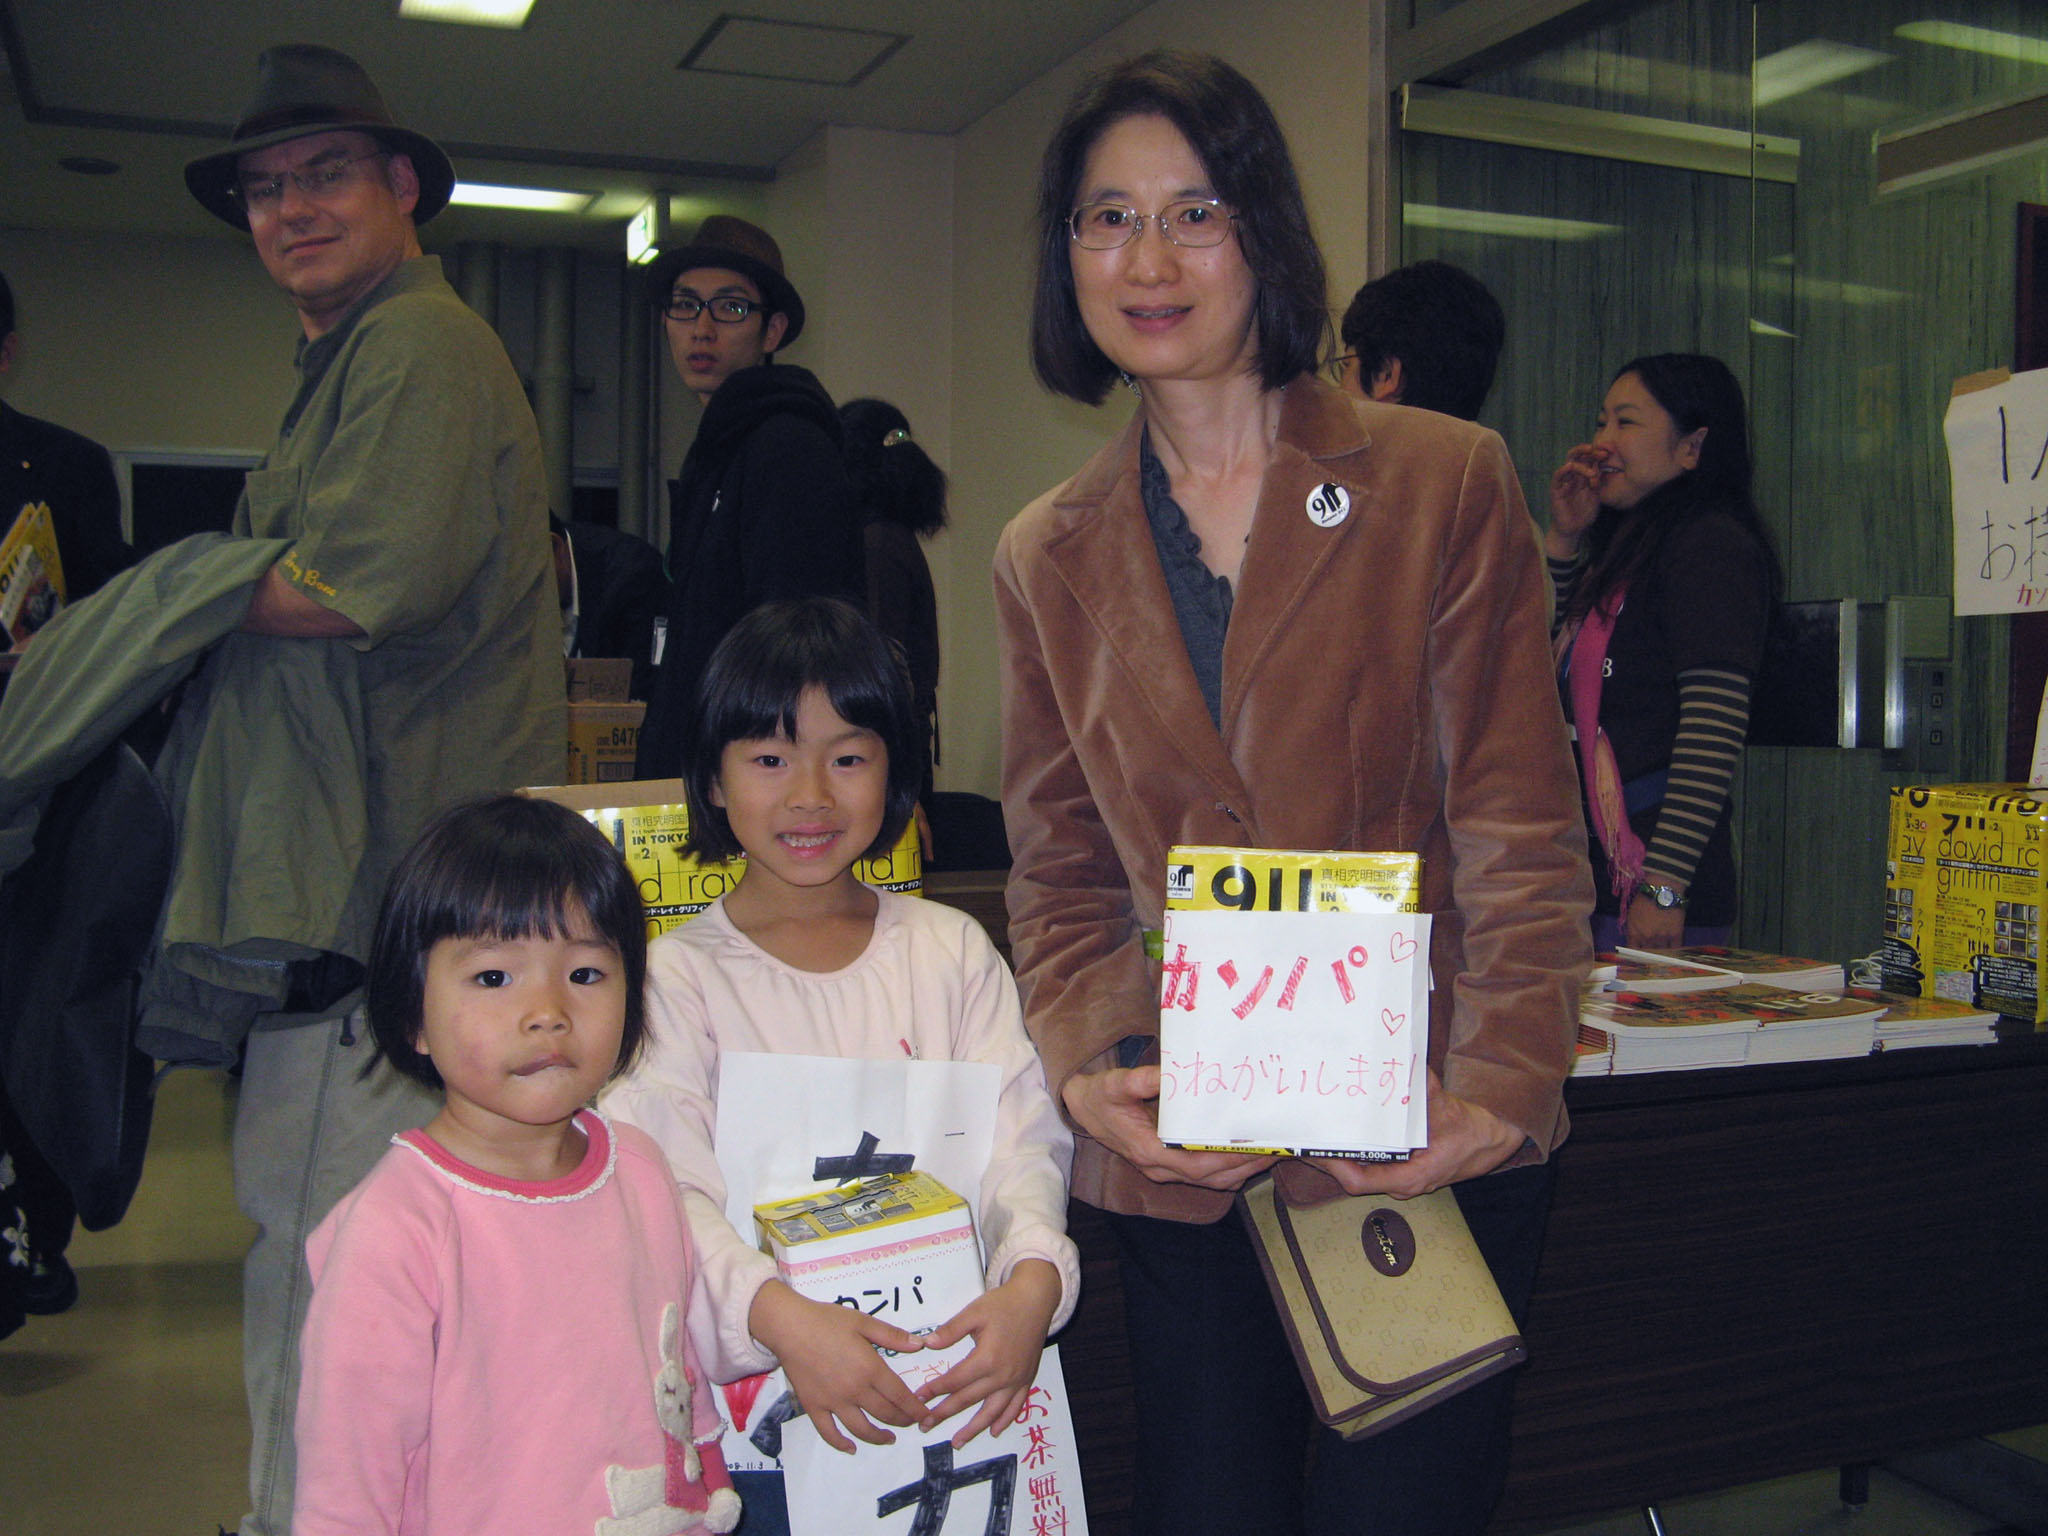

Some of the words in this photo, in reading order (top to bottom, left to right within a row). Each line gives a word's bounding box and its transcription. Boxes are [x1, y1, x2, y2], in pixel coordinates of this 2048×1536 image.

[632, 836, 646, 846] IN
[1938, 830, 2004, 863] david
[1937, 858, 2001, 895] griffin
